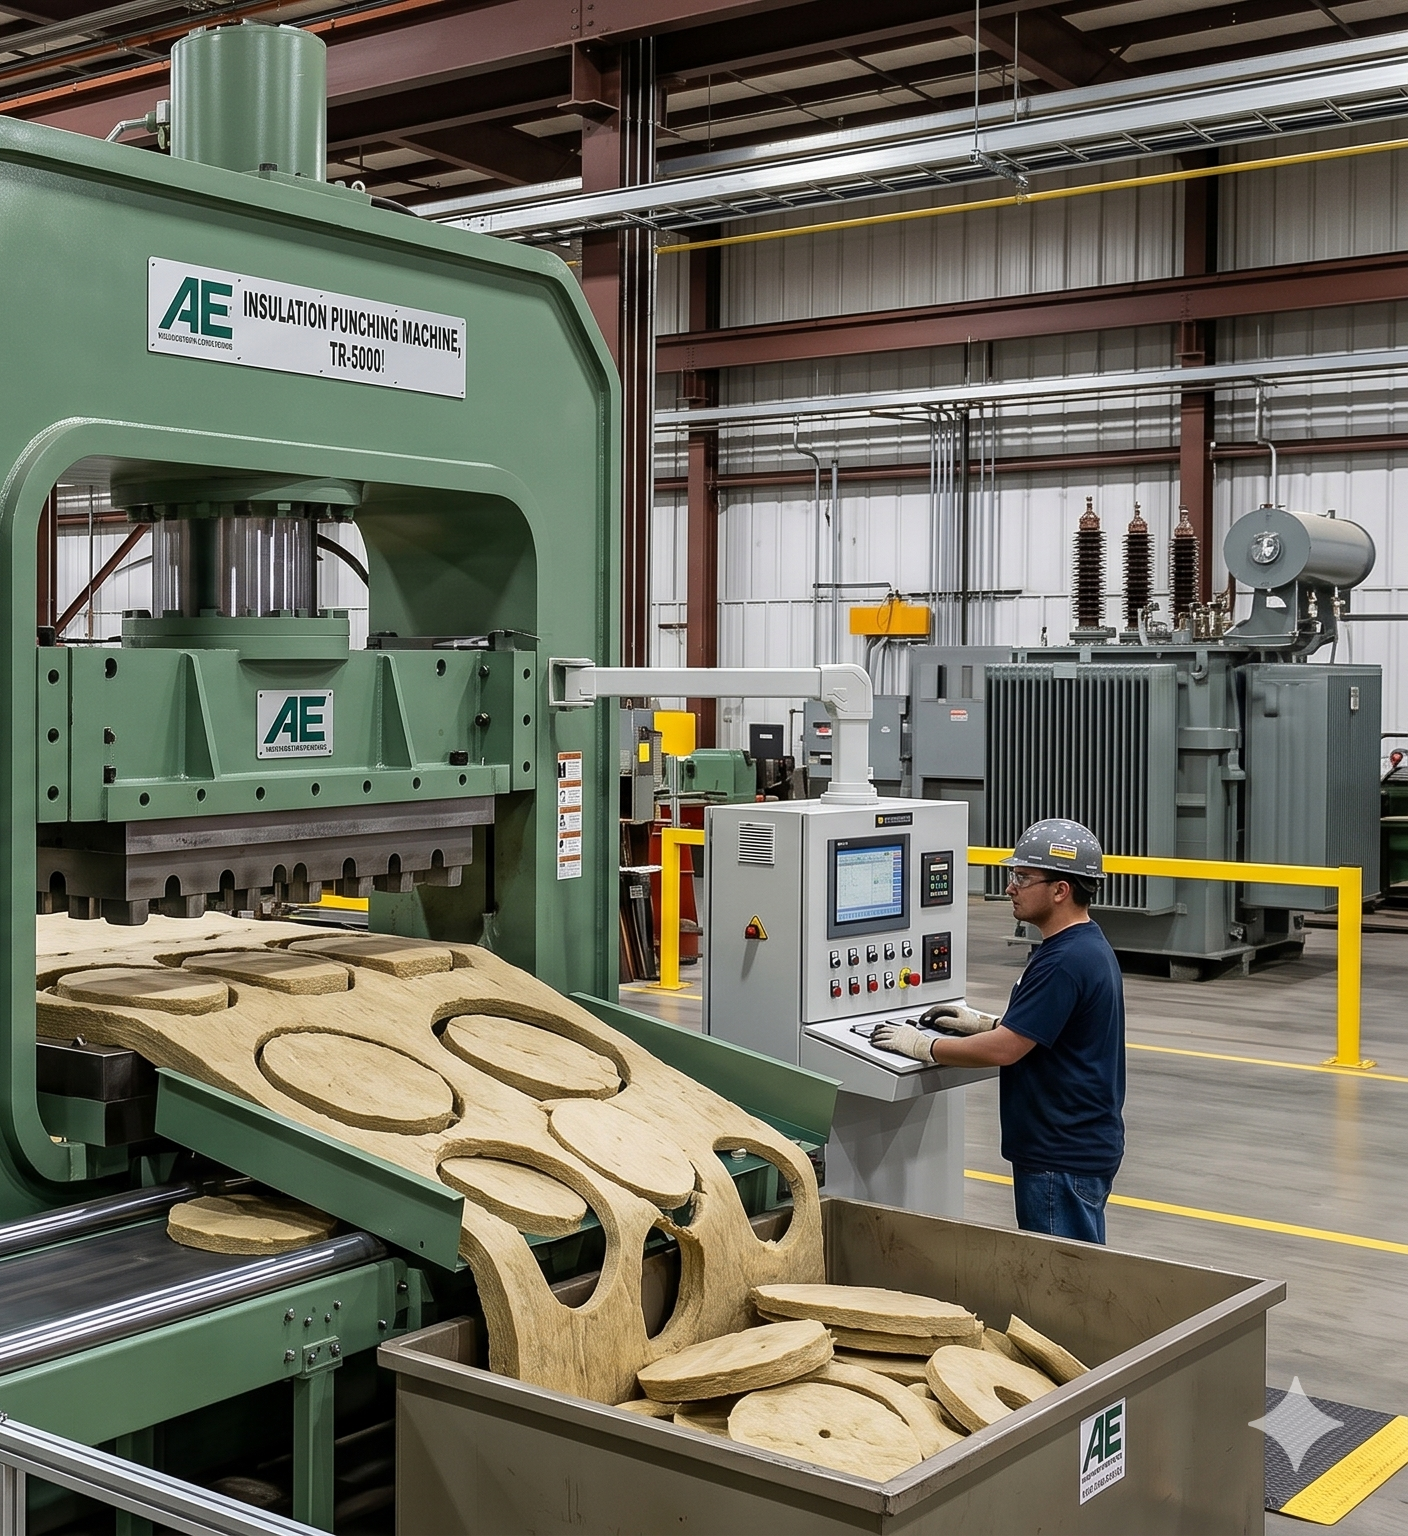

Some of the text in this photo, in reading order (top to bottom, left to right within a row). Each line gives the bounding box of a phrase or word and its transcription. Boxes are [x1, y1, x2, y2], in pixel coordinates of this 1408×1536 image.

[158, 276, 233, 340] AE
[243, 290, 461, 359] INSULATION PUNCHING MACHINE,
[329, 341, 385, 373] TR-5000!
[263, 696, 327, 744] AE
[1082, 1403, 1123, 1474] AE
